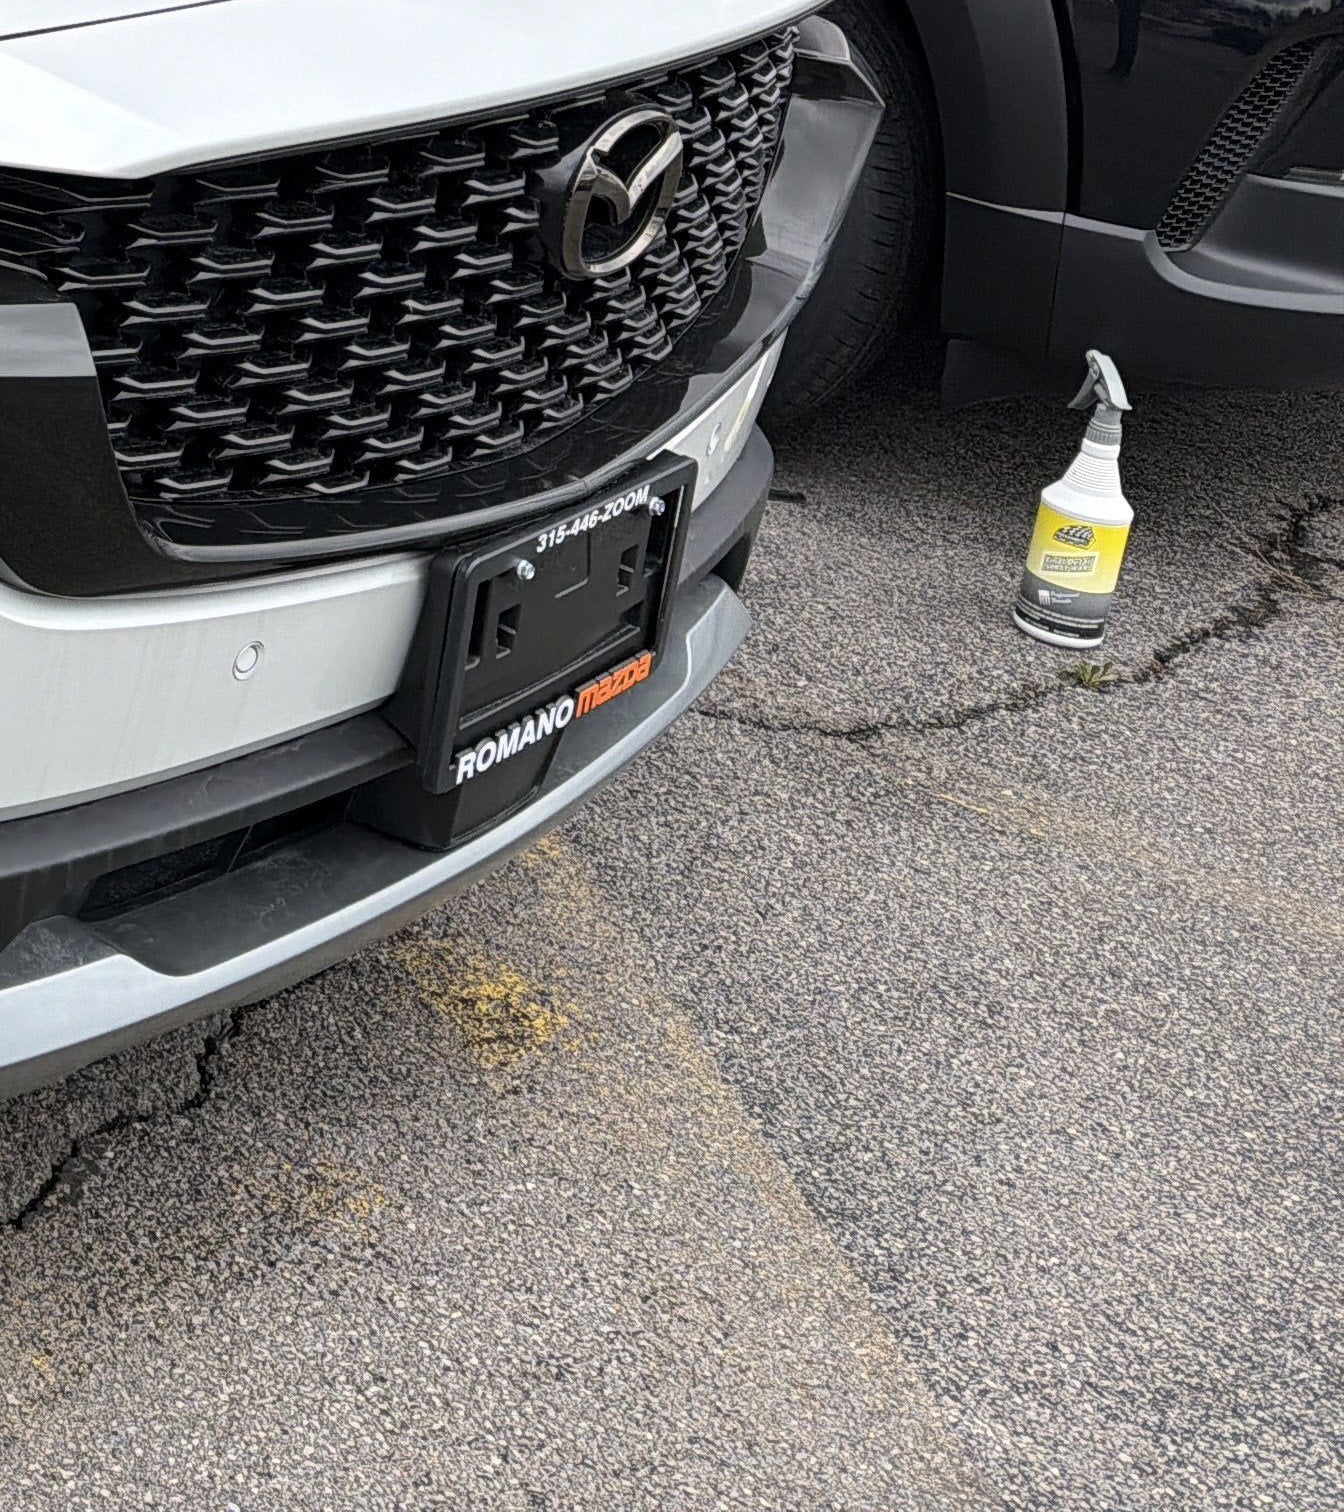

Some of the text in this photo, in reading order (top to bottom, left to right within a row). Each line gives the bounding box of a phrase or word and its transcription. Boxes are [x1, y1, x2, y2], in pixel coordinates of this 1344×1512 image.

[535, 484, 650, 554] 315-446-ZOOM
[455, 651, 653, 785] ROMANO mazda
